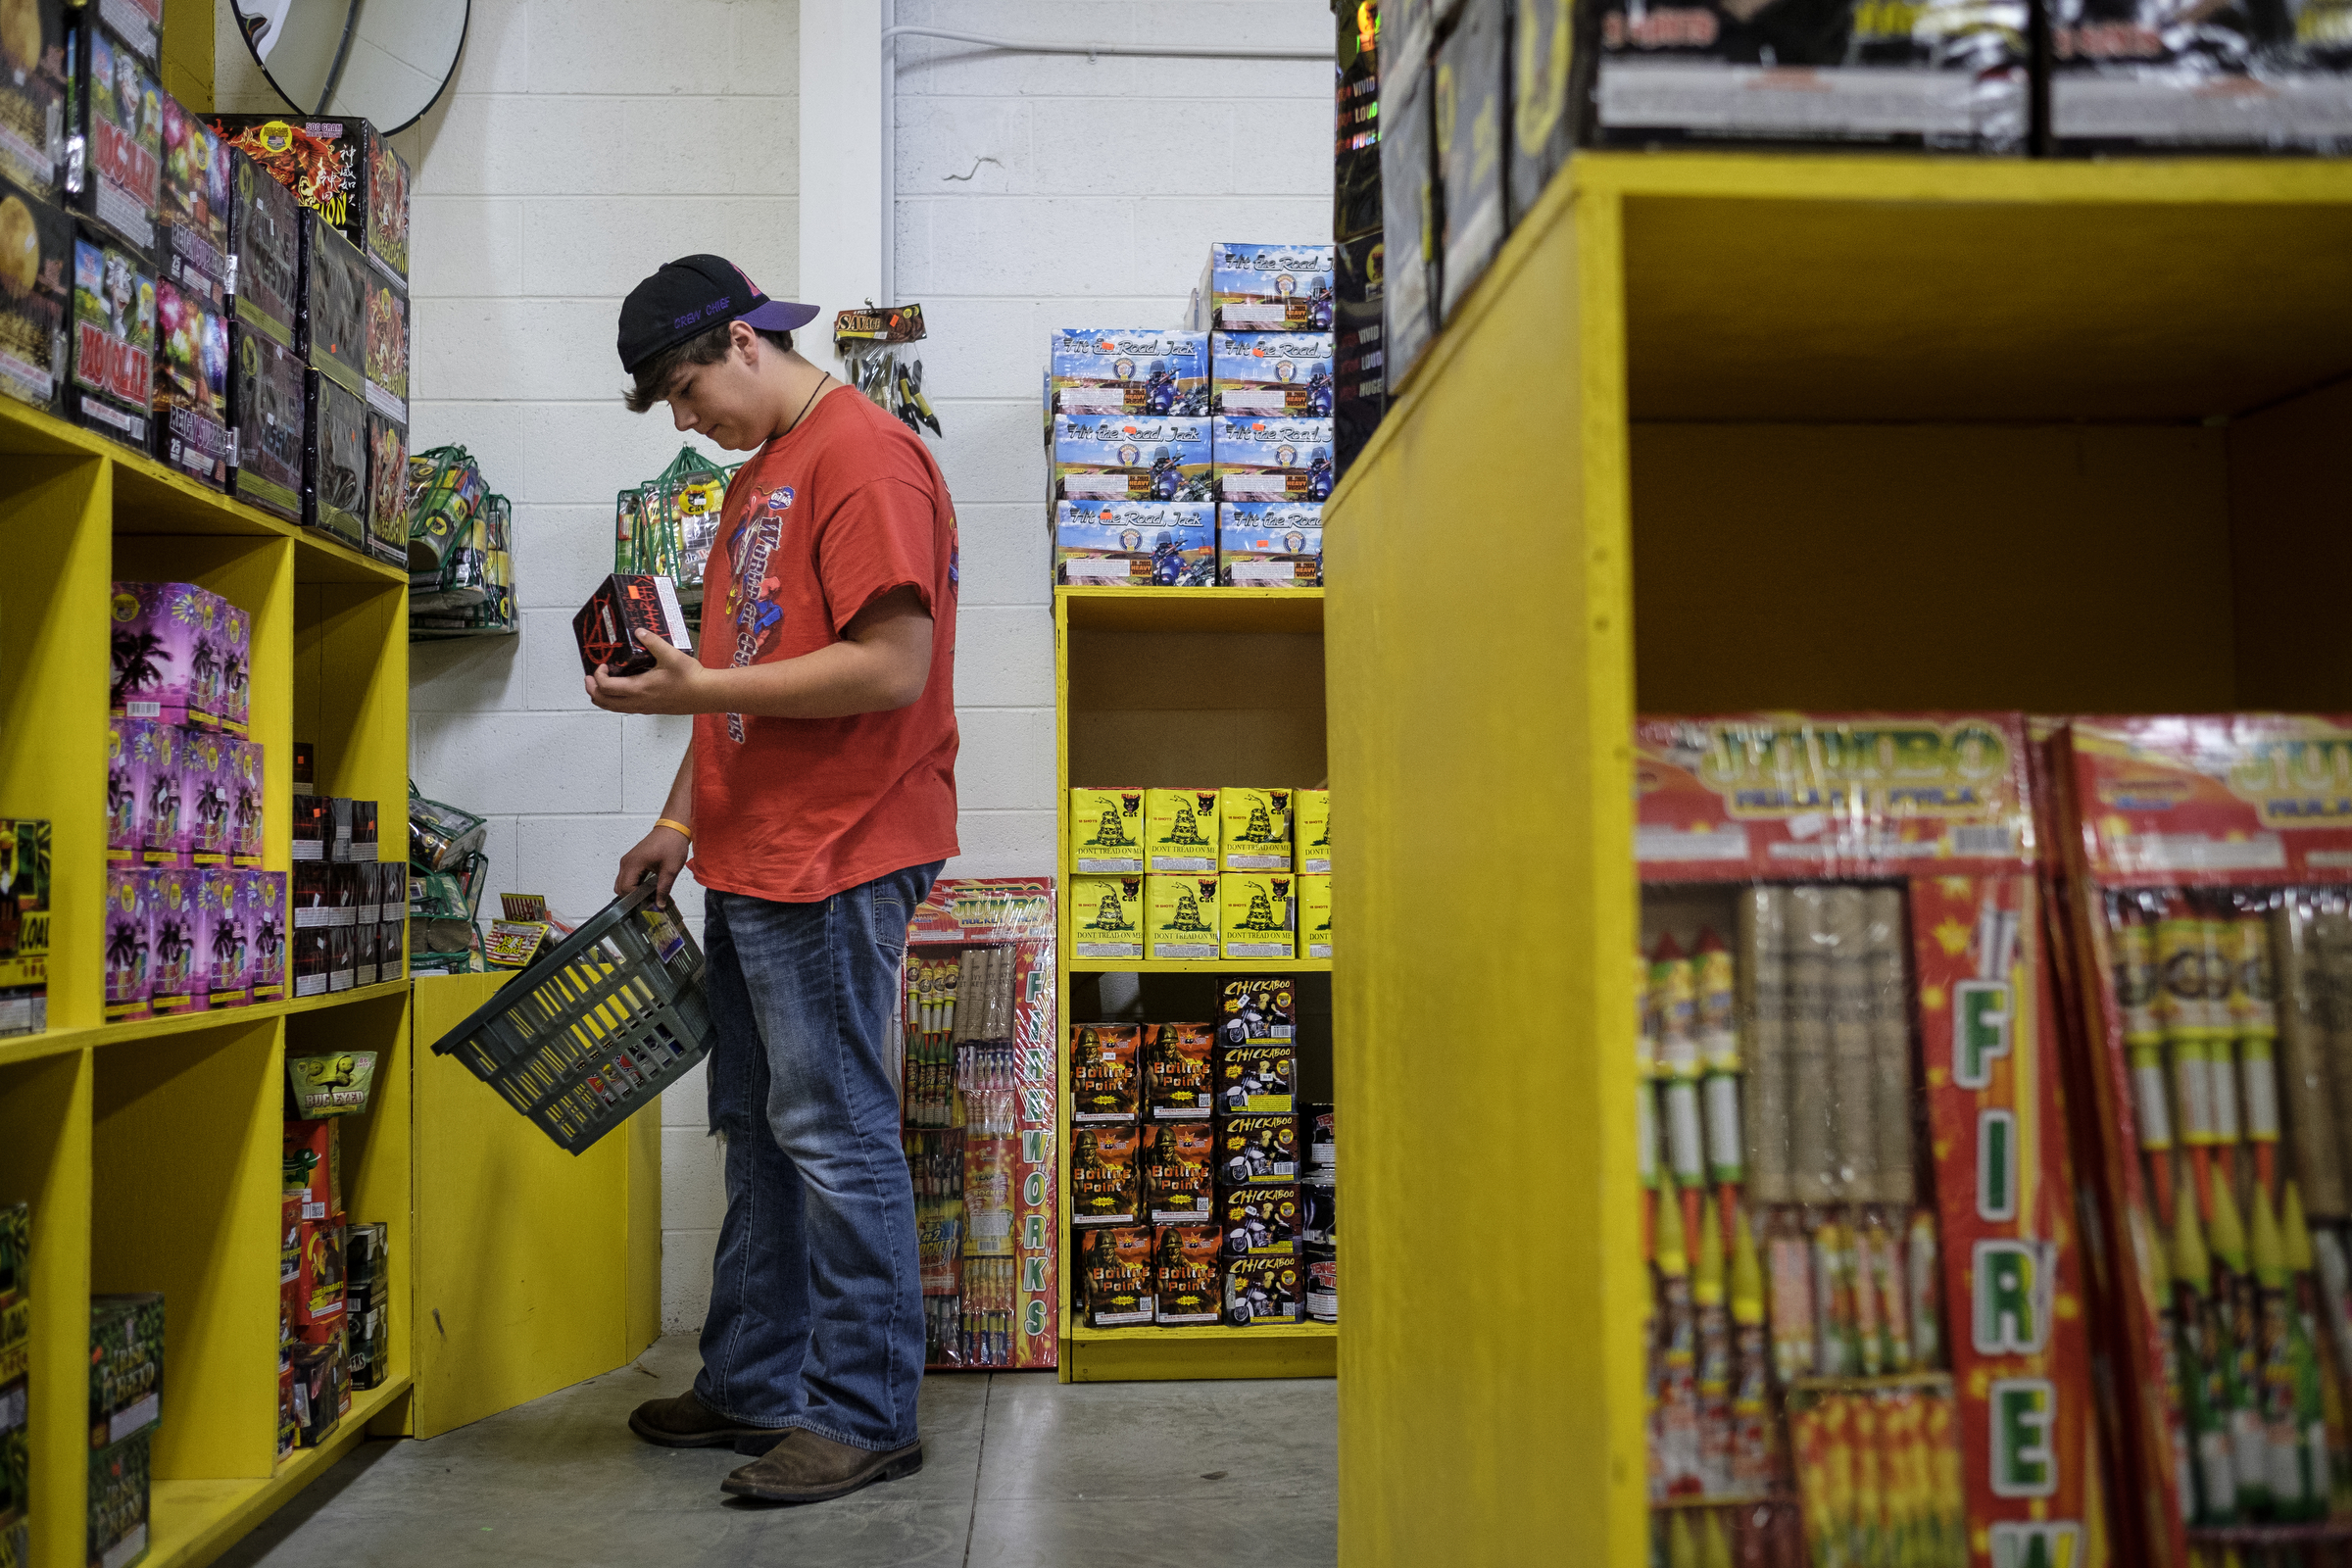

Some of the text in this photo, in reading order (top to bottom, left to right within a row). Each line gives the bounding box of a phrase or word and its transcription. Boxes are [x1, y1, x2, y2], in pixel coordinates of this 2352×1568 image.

[1353, 75, 1375, 97] VIVID
[1355, 101, 1378, 123] LOUD
[322, 123, 342, 132] GRAM
[1353, 129, 1376, 150] HUGE
[1225, 254, 1250, 270] Hit
[1254, 255, 1276, 271] the
[674, 296, 730, 328] CREW CHIEF
[837, 314, 880, 331] SAVAGE
[1358, 325, 1380, 344] VIVID
[1063, 338, 1089, 353] Hit
[1161, 341, 1197, 356] Jack
[1225, 340, 1250, 356] Hit
[1361, 350, 1383, 370] LOUD
[1358, 378, 1383, 398] HUGE
[170, 405, 197, 444] REIGN
[1226, 424, 1250, 439] Hit
[1067, 424, 1093, 439] Hit
[1096, 424, 1119, 441] the
[1165, 427, 1200, 442] Jack
[171, 438, 180, 452] 25
[1070, 508, 1095, 523] Hit
[1167, 512, 1203, 527] Jack
[1234, 512, 1285, 528] Hit the
[747, 515, 783, 601] WORLD
[741, 602, 758, 630] OF
[1224, 980, 1291, 995] CHICKABOO
[1224, 1048, 1291, 1062] CHICKABOO
[1076, 1066, 1133, 1078] Boiling
[1154, 1062, 1210, 1074] Boiling
[1085, 1080, 1123, 1091] Point
[1163, 1076, 1200, 1087] Point
[305, 1090, 365, 1109] BUG EYED
[1227, 1116, 1293, 1133] CHICKABOO
[1024, 970, 1049, 1336] FIREWORKS
[1074, 1167, 1131, 1180] Boiling
[1152, 1165, 1208, 1177] Boiling
[1084, 1181, 1121, 1193] Point
[1161, 1179, 1200, 1191] Point
[1228, 1191, 1295, 1205] CHICKABOO
[922, 1229, 941, 1242] #2
[919, 1240, 952, 1254] OCKET
[1093, 1266, 1150, 1279] Boiling
[1158, 1266, 1215, 1279] Boiling
[1229, 1257, 1295, 1274] CHICKABOO
[1103, 1280, 1141, 1292] Point
[1168, 1280, 1205, 1292] Point
